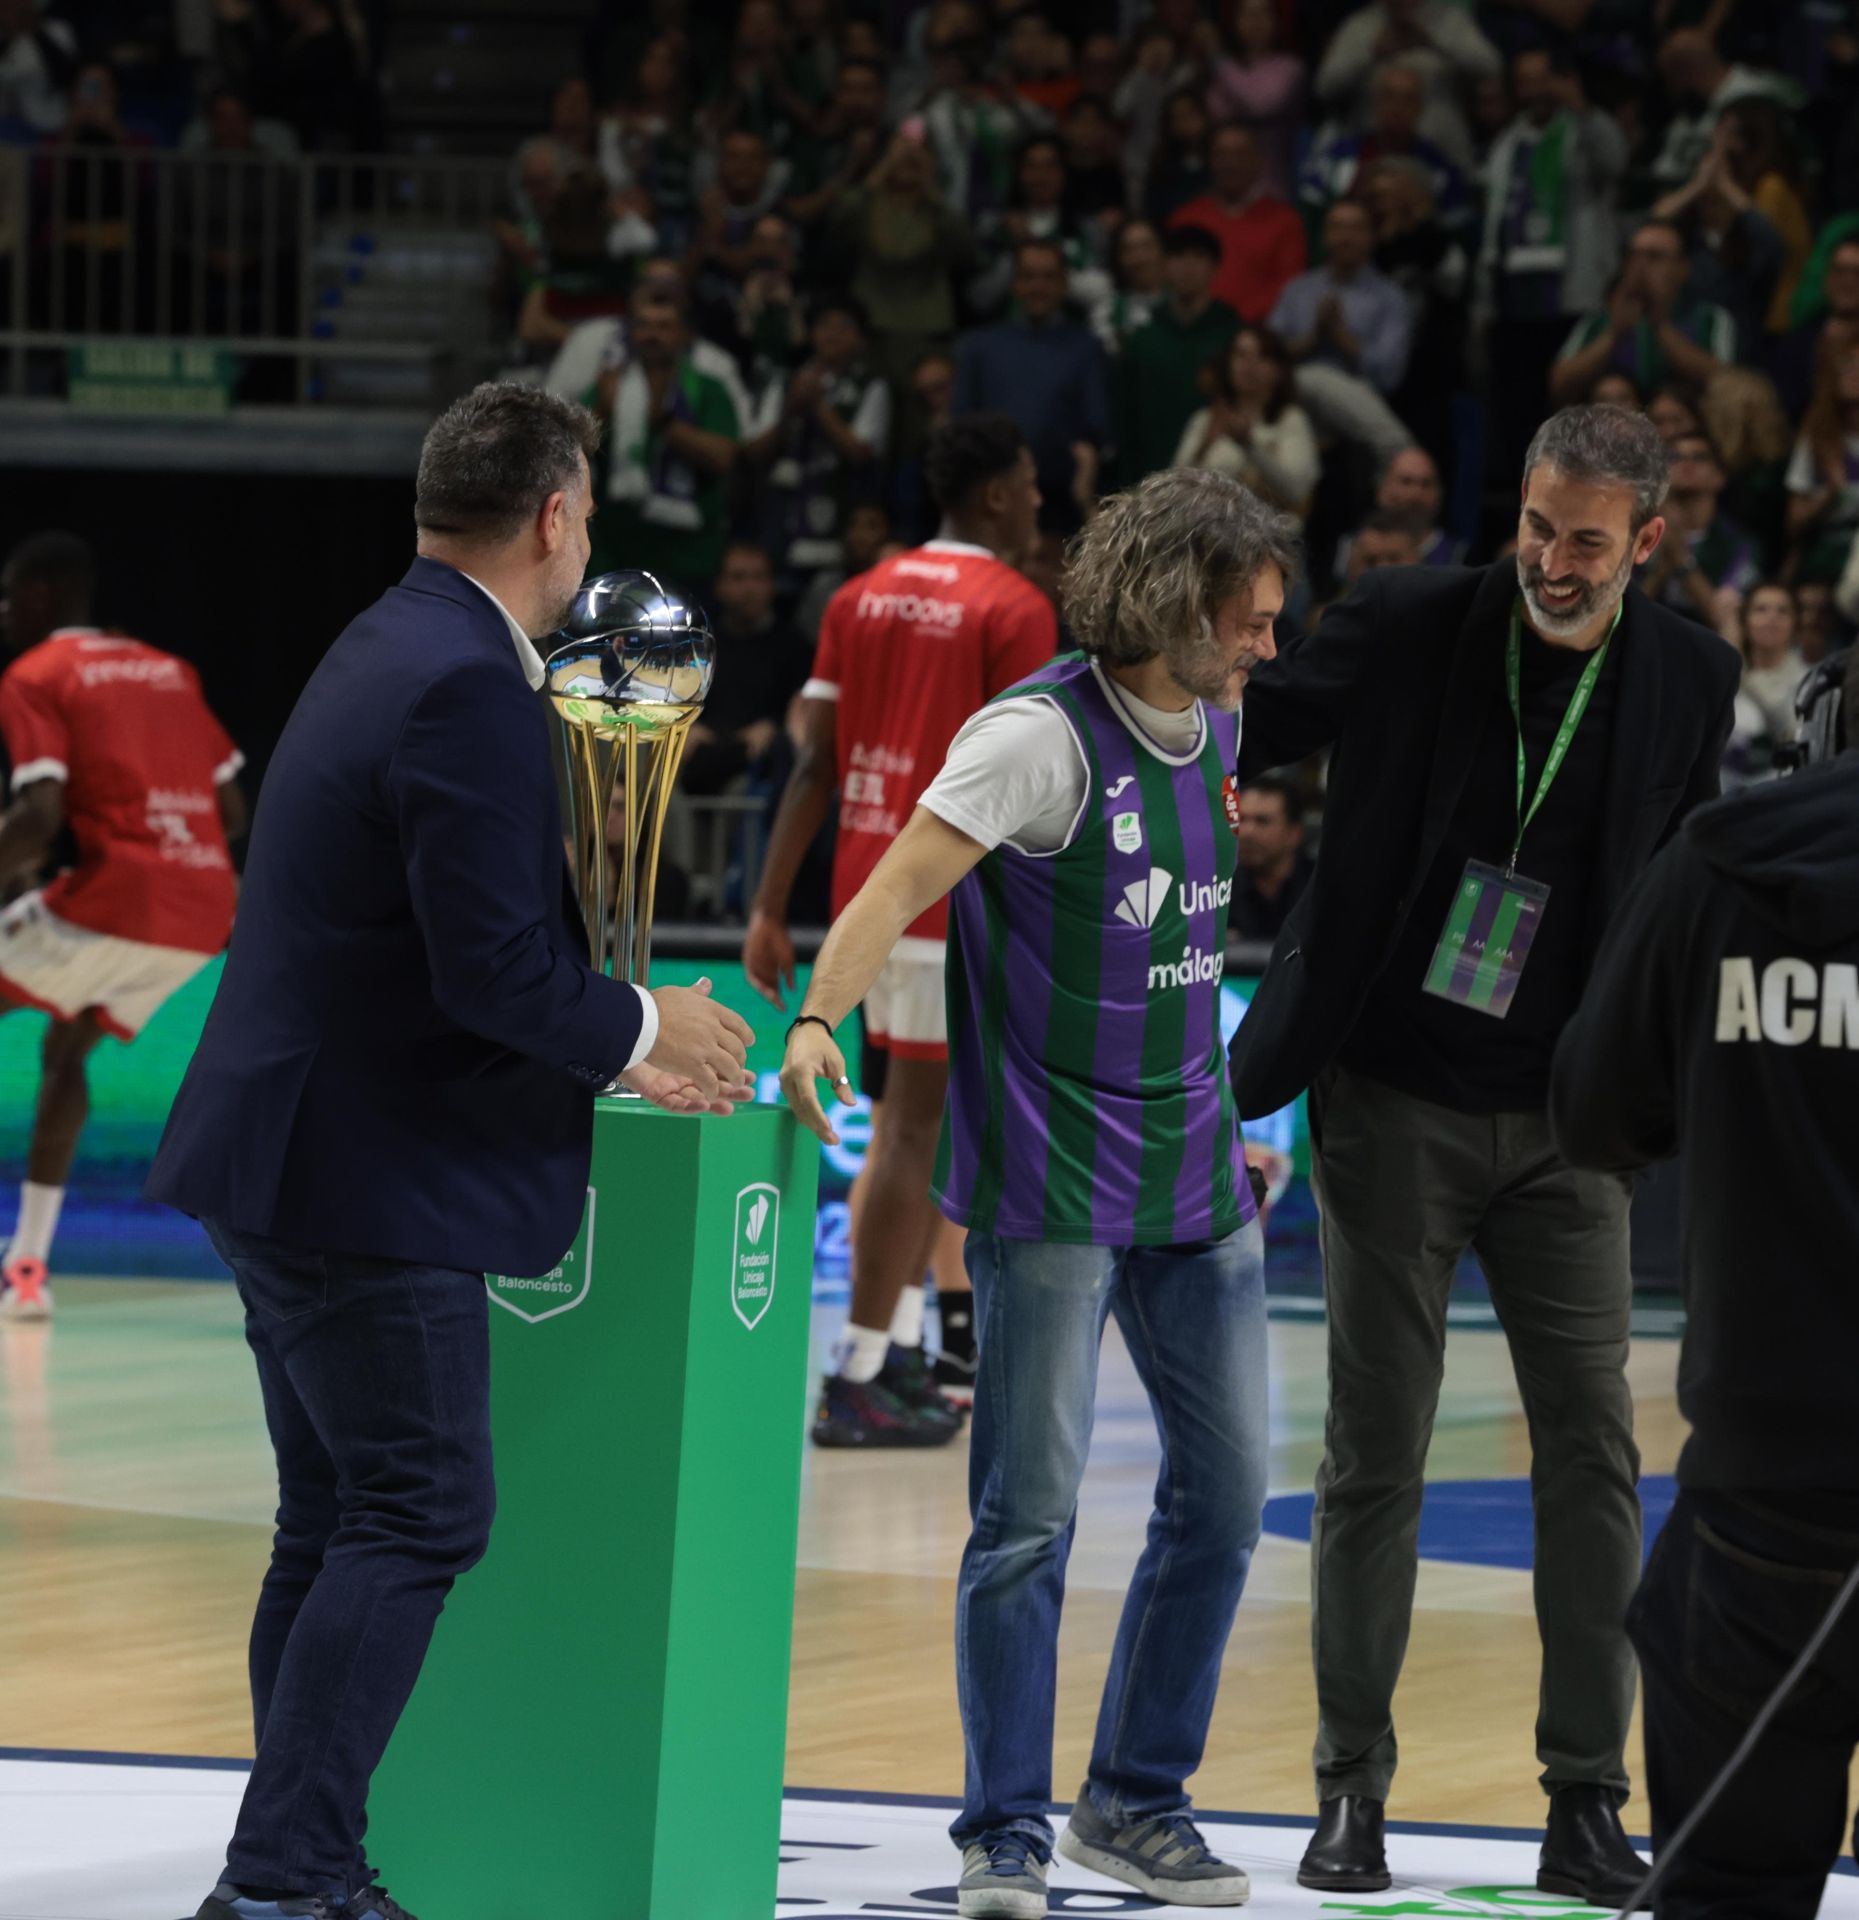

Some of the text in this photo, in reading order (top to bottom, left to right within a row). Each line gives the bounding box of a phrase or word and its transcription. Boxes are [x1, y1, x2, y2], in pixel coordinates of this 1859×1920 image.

[1715, 956, 1859, 1050] ACM
[740, 1250, 769, 1268] Fundación
[498, 1275, 573, 1293] Baloncesto
[743, 1269, 764, 1286] Unicaja
[738, 1286, 768, 1299] Baloncesto
